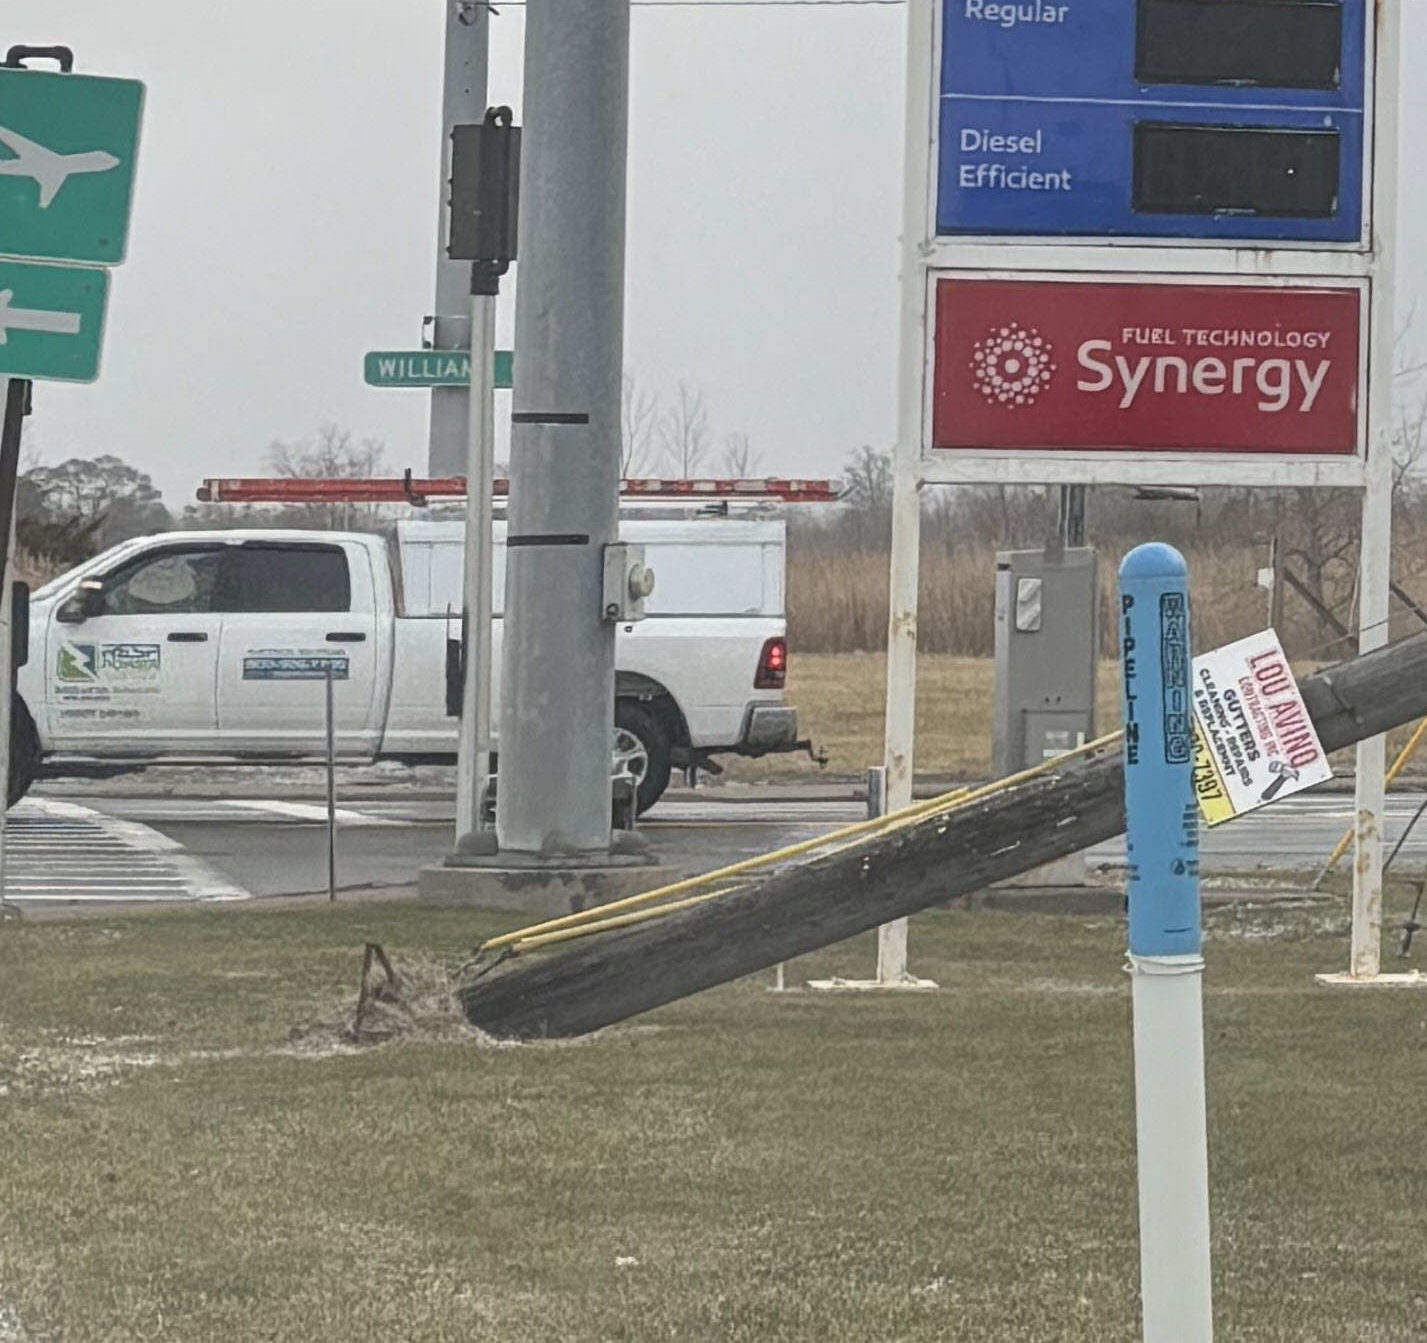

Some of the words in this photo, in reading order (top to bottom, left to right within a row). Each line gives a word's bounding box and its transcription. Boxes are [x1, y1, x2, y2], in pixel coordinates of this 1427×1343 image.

[958, 163, 1073, 190] Efficient
[960, 128, 1042, 154] Diesel
[1122, 327, 1176, 345] FUEL
[1182, 328, 1331, 349] TECHNOLOGY
[1077, 339, 1332, 412] Synergy
[1122, 594, 1139, 765] PIPELINE
[1250, 650, 1291, 696] LOU
[1200, 668, 1231, 728] CLEANING
[1225, 735, 1254, 787] REPAIRS
[1223, 689, 1261, 762] GUTTERS
[1269, 699, 1319, 770] AVINO
